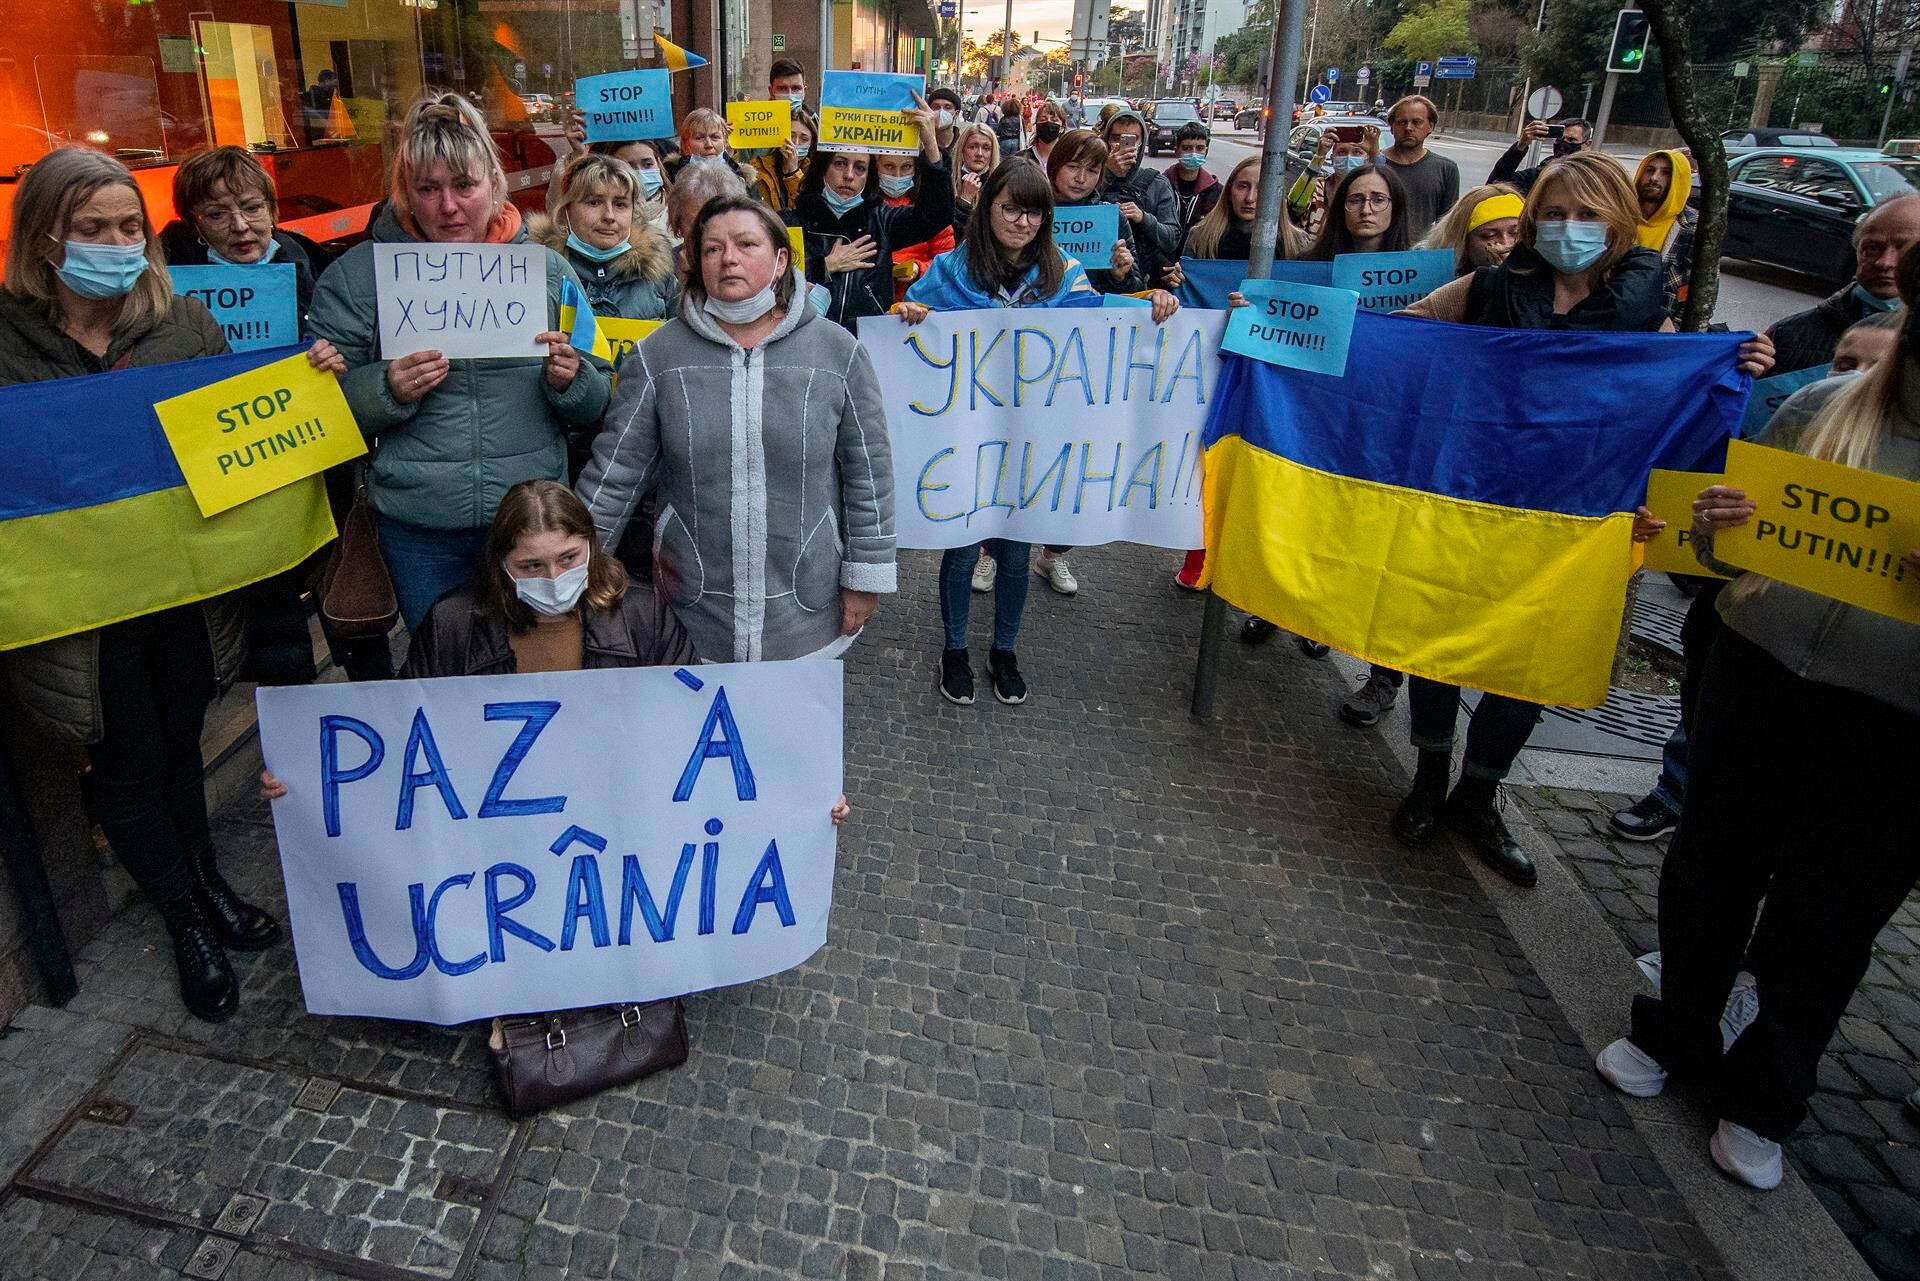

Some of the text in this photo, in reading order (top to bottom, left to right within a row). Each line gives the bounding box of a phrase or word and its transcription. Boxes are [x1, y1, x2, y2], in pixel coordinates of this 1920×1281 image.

[1329, 69, 1337, 79] P
[1419, 63, 1429, 74] P
[600, 86, 643, 103] STOP
[593, 108, 655, 125] PUTIN!!!
[744, 111, 773, 122] STOP
[834, 112, 907, 127] РУКИ ГЕТЬ ВІД
[739, 126, 780, 137] PUTIN!!!
[833, 125, 904, 143] УКРАЇНИ
[1052, 221, 1094, 234] STOP
[394, 251, 528, 285] ПУТИН
[1361, 269, 1418, 287] STOP
[1266, 298, 1320, 322] STOP
[1249, 323, 1326, 352] PUTIN!!!
[904, 317, 1206, 417] УКРАЇНА
[216, 388, 292, 434] STOP
[216, 417, 326, 476] PUTIN!!!
[1781, 483, 1890, 529] STOP
[320, 667, 758, 838] PAZ À
